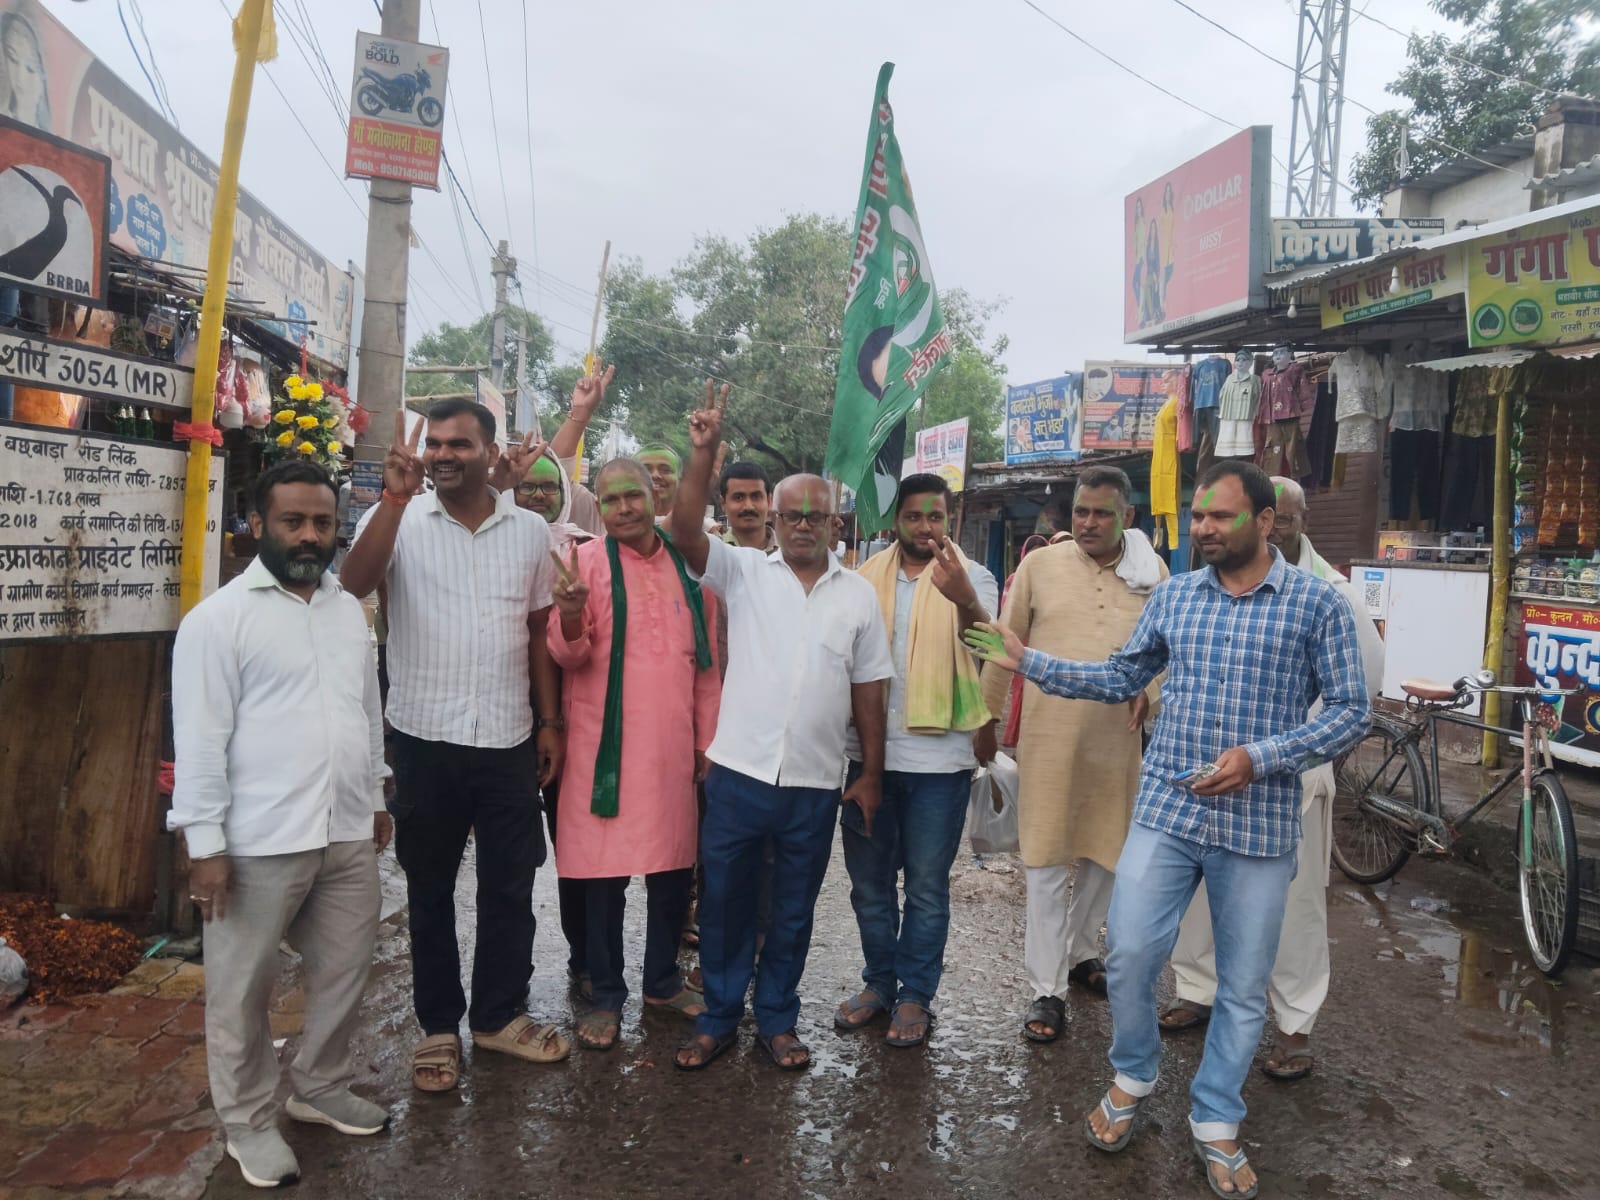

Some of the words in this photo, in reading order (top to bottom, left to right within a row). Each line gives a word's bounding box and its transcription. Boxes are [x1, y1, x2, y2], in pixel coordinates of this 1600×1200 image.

[88, 85, 159, 195] प्रभात
[1273, 219, 1361, 262] किरण
[1482, 229, 1569, 284] गंगा
[46, 271, 91, 296] BRRDA
[1328, 279, 1360, 311] गंगा
[57, 353, 119, 390] 3054
[124, 363, 177, 403] (MR)
[78, 440, 105, 462] रोड
[107, 443, 137, 467] लिंक
[127, 513, 141, 534] की
[77, 536, 136, 574] प्राइवेट
[7, 579, 43, 603] ग्रामीण
[101, 578, 120, 598] कार्य
[1550, 610, 1574, 625] कुन्दन
[1525, 622, 1600, 703] कुन्द
